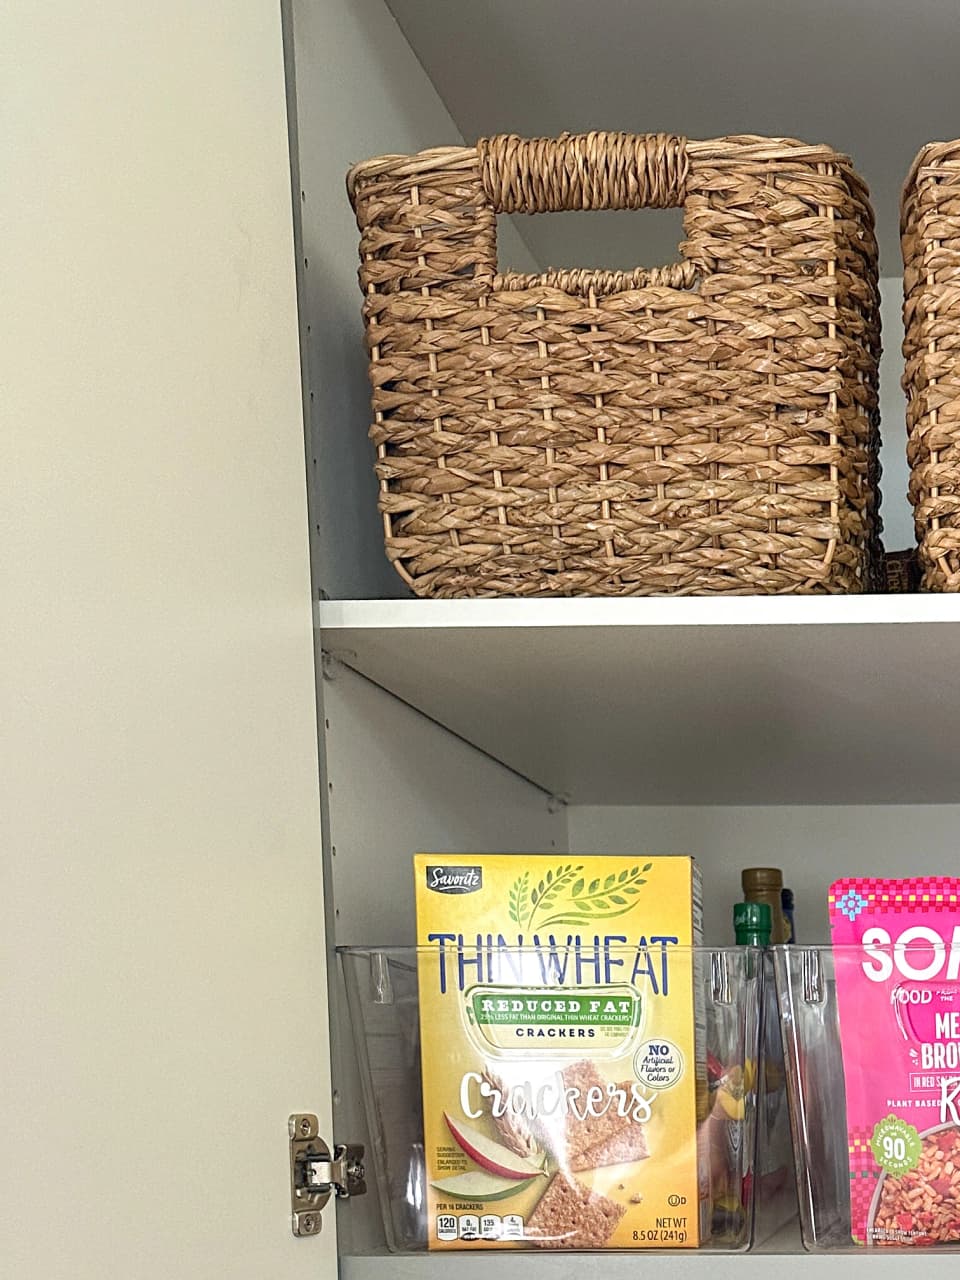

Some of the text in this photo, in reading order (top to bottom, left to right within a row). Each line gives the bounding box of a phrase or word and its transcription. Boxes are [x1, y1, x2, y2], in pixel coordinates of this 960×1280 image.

[430, 867, 480, 888] Savoritz
[428, 933, 679, 996] THIN WHEAT
[482, 999, 631, 1013] REDUCED FAT
[515, 1028, 596, 1038] CRACKERS
[648, 1045, 670, 1056] NO
[642, 1056, 674, 1067] Artificial
[640, 1065, 667, 1073] Flavors
[647, 1073, 670, 1082] Colors
[460, 1070, 657, 1123] Crackers
[887, 1100, 913, 1108] PLANT
[915, 1099, 942, 1107] BASED
[882, 1136, 906, 1159] 90
[879, 1157, 913, 1169] SECONDS
[439, 1218, 455, 1228] 120
[656, 1218, 687, 1228] NET WT
[632, 1230, 687, 1242] 8.5 OZ (241g)
